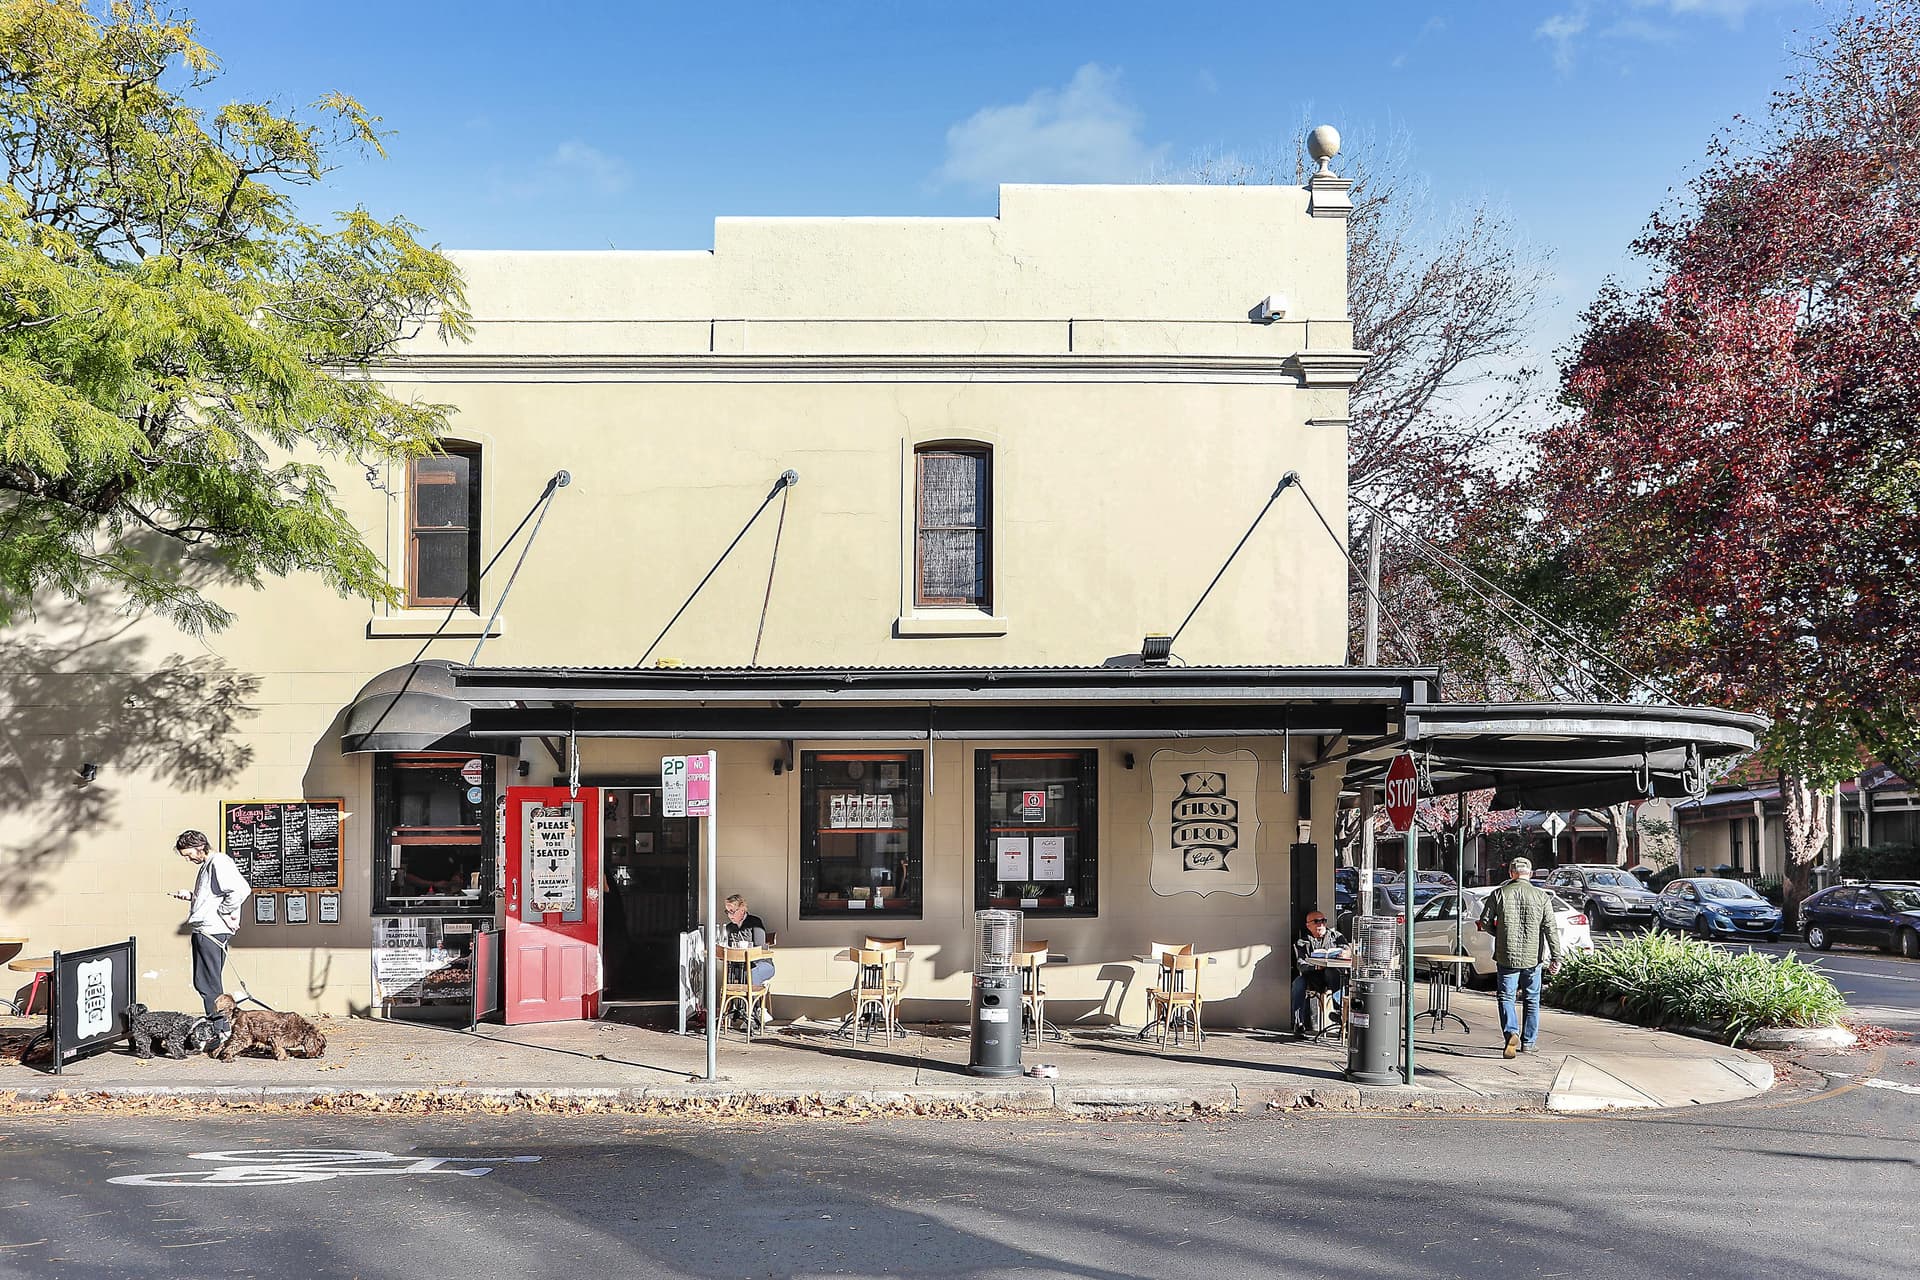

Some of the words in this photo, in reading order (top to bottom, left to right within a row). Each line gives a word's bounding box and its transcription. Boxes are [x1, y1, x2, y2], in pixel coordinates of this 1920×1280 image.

[664, 761, 684, 775] 2P
[694, 761, 704, 769] NO
[1387, 778, 1416, 809] STOP
[227, 804, 264, 823] Takeaway
[1181, 802, 1229, 817] FIRST
[1181, 827, 1230, 842] DROP
